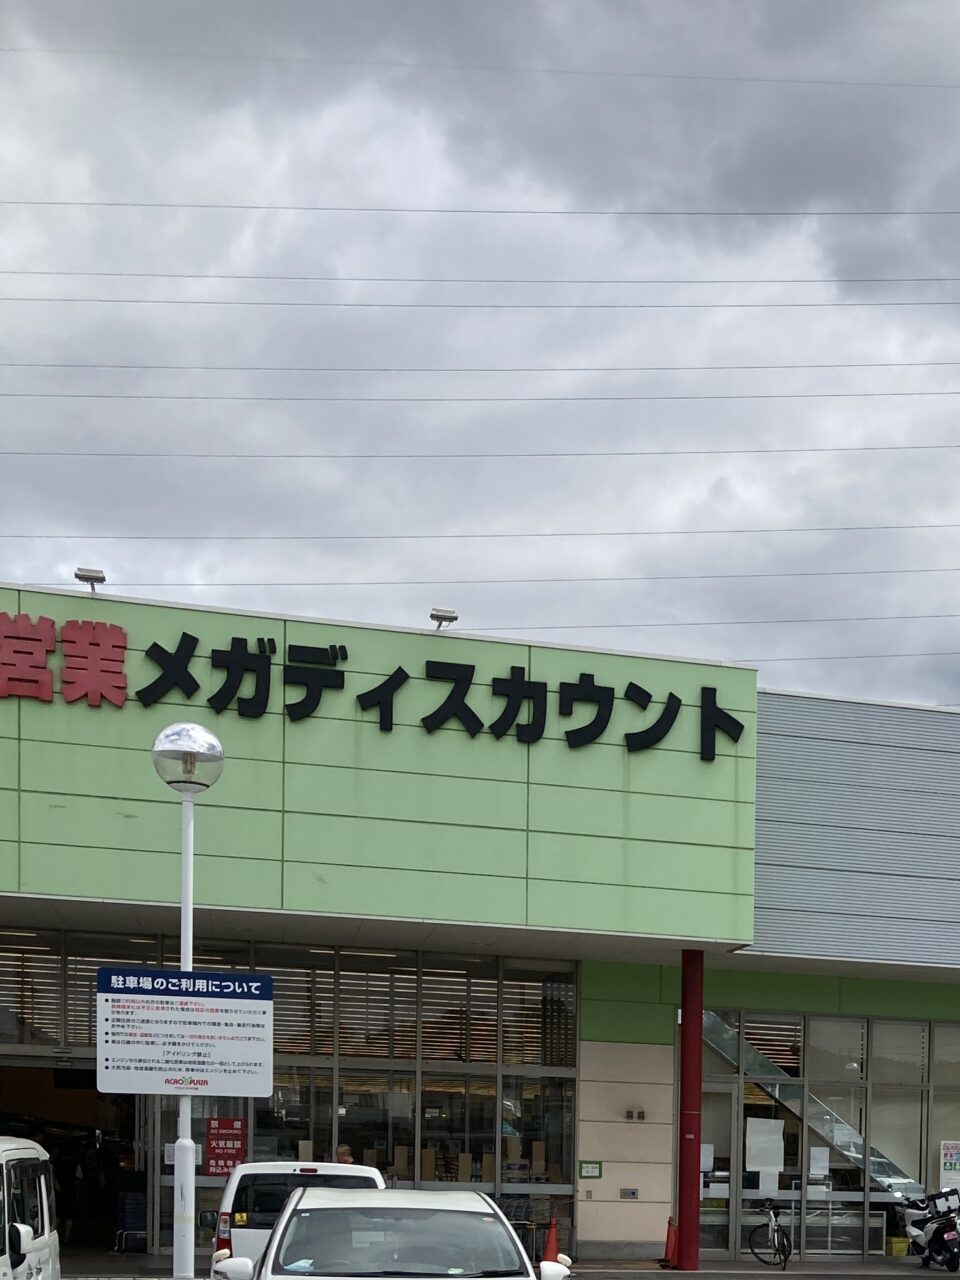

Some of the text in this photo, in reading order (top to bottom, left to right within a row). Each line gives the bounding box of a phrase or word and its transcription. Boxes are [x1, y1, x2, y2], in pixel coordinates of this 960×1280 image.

[0, 611, 745, 762] 営業 メガディスカウント
[111, 975, 262, 995] 駐車場のご利用について
